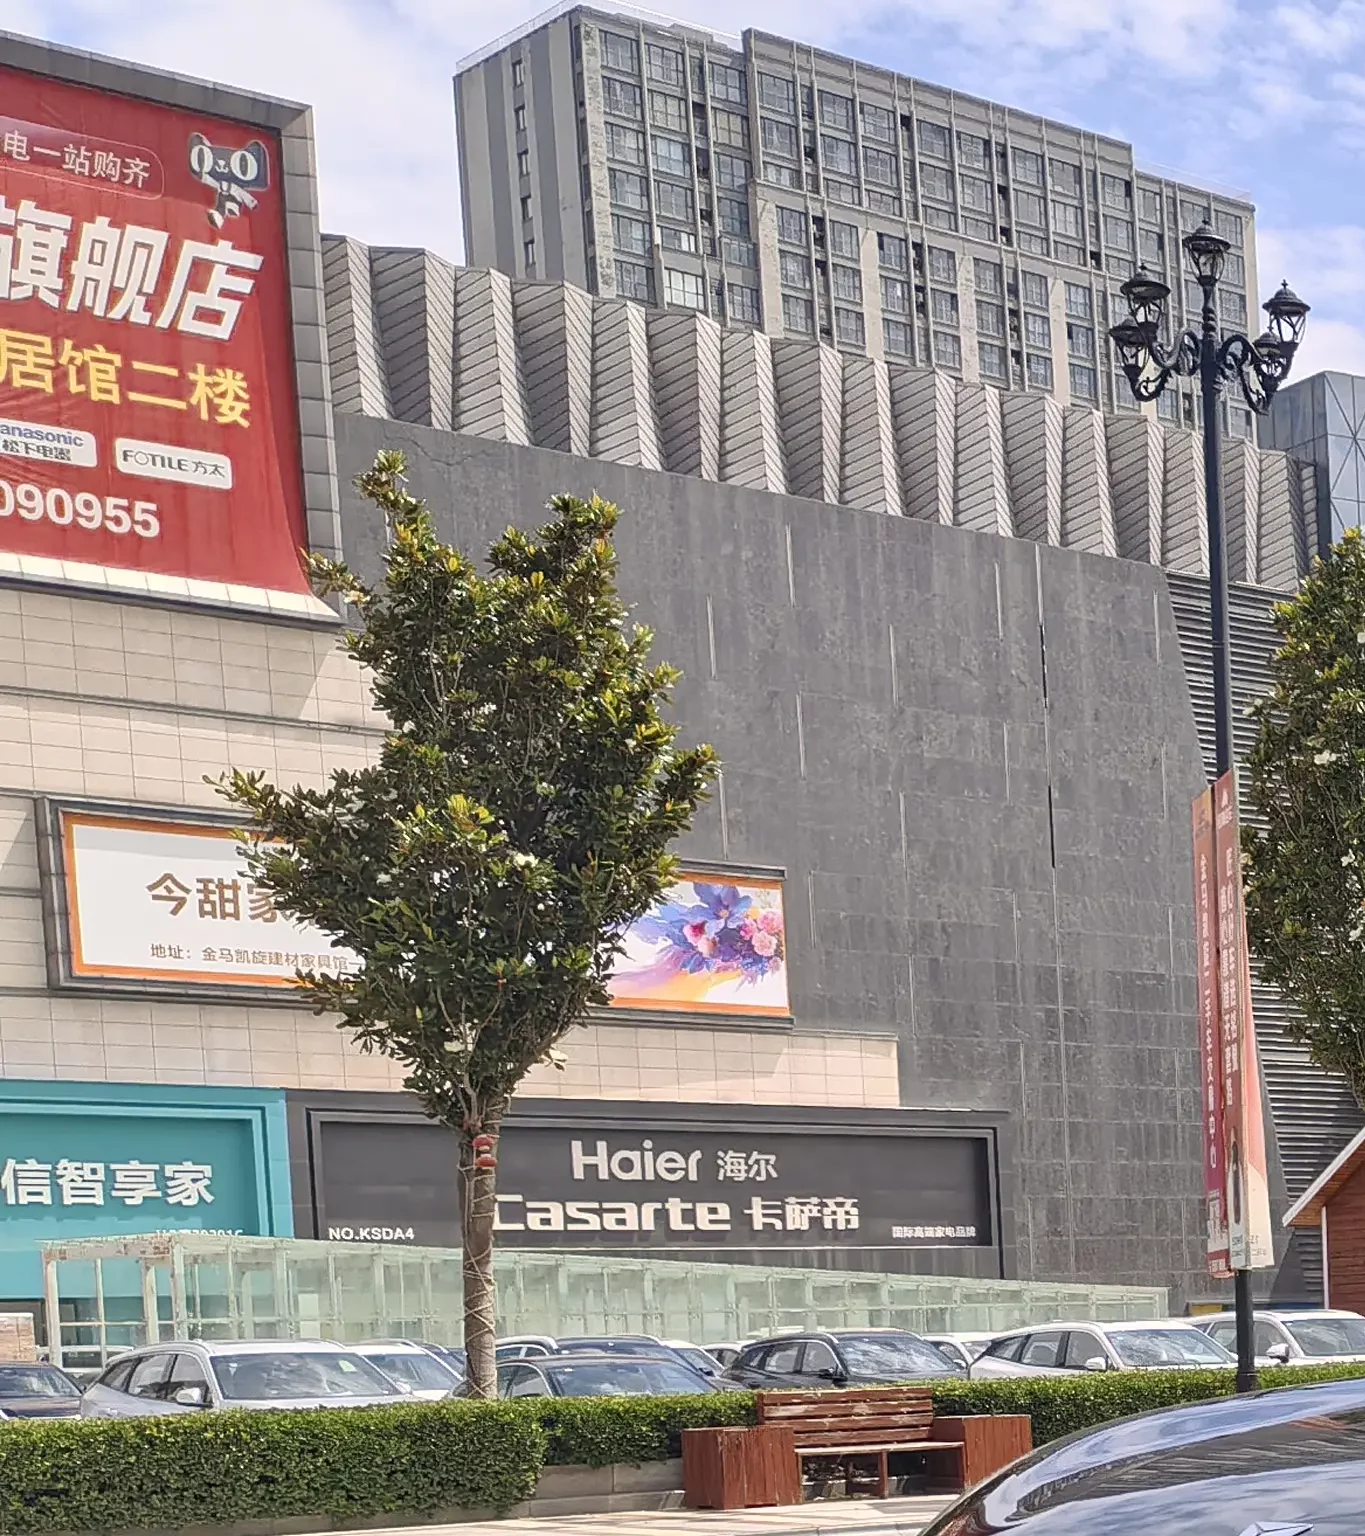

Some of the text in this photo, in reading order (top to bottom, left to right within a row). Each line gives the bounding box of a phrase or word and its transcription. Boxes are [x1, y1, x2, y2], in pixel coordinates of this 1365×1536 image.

[3, 129, 150, 189] 电一站购齐
[0, 195, 264, 341] 旗舰店
[0, 328, 250, 428] 居馆二楼
[122, 449, 189, 472] FOTILE
[0, 1158, 215, 1207] 信智享家
[571, 1139, 779, 1182] Haier 海尔
[327, 1226, 416, 1241] NO.KSDA4
[492, 1193, 860, 1232] Casarte 卡萨帝
